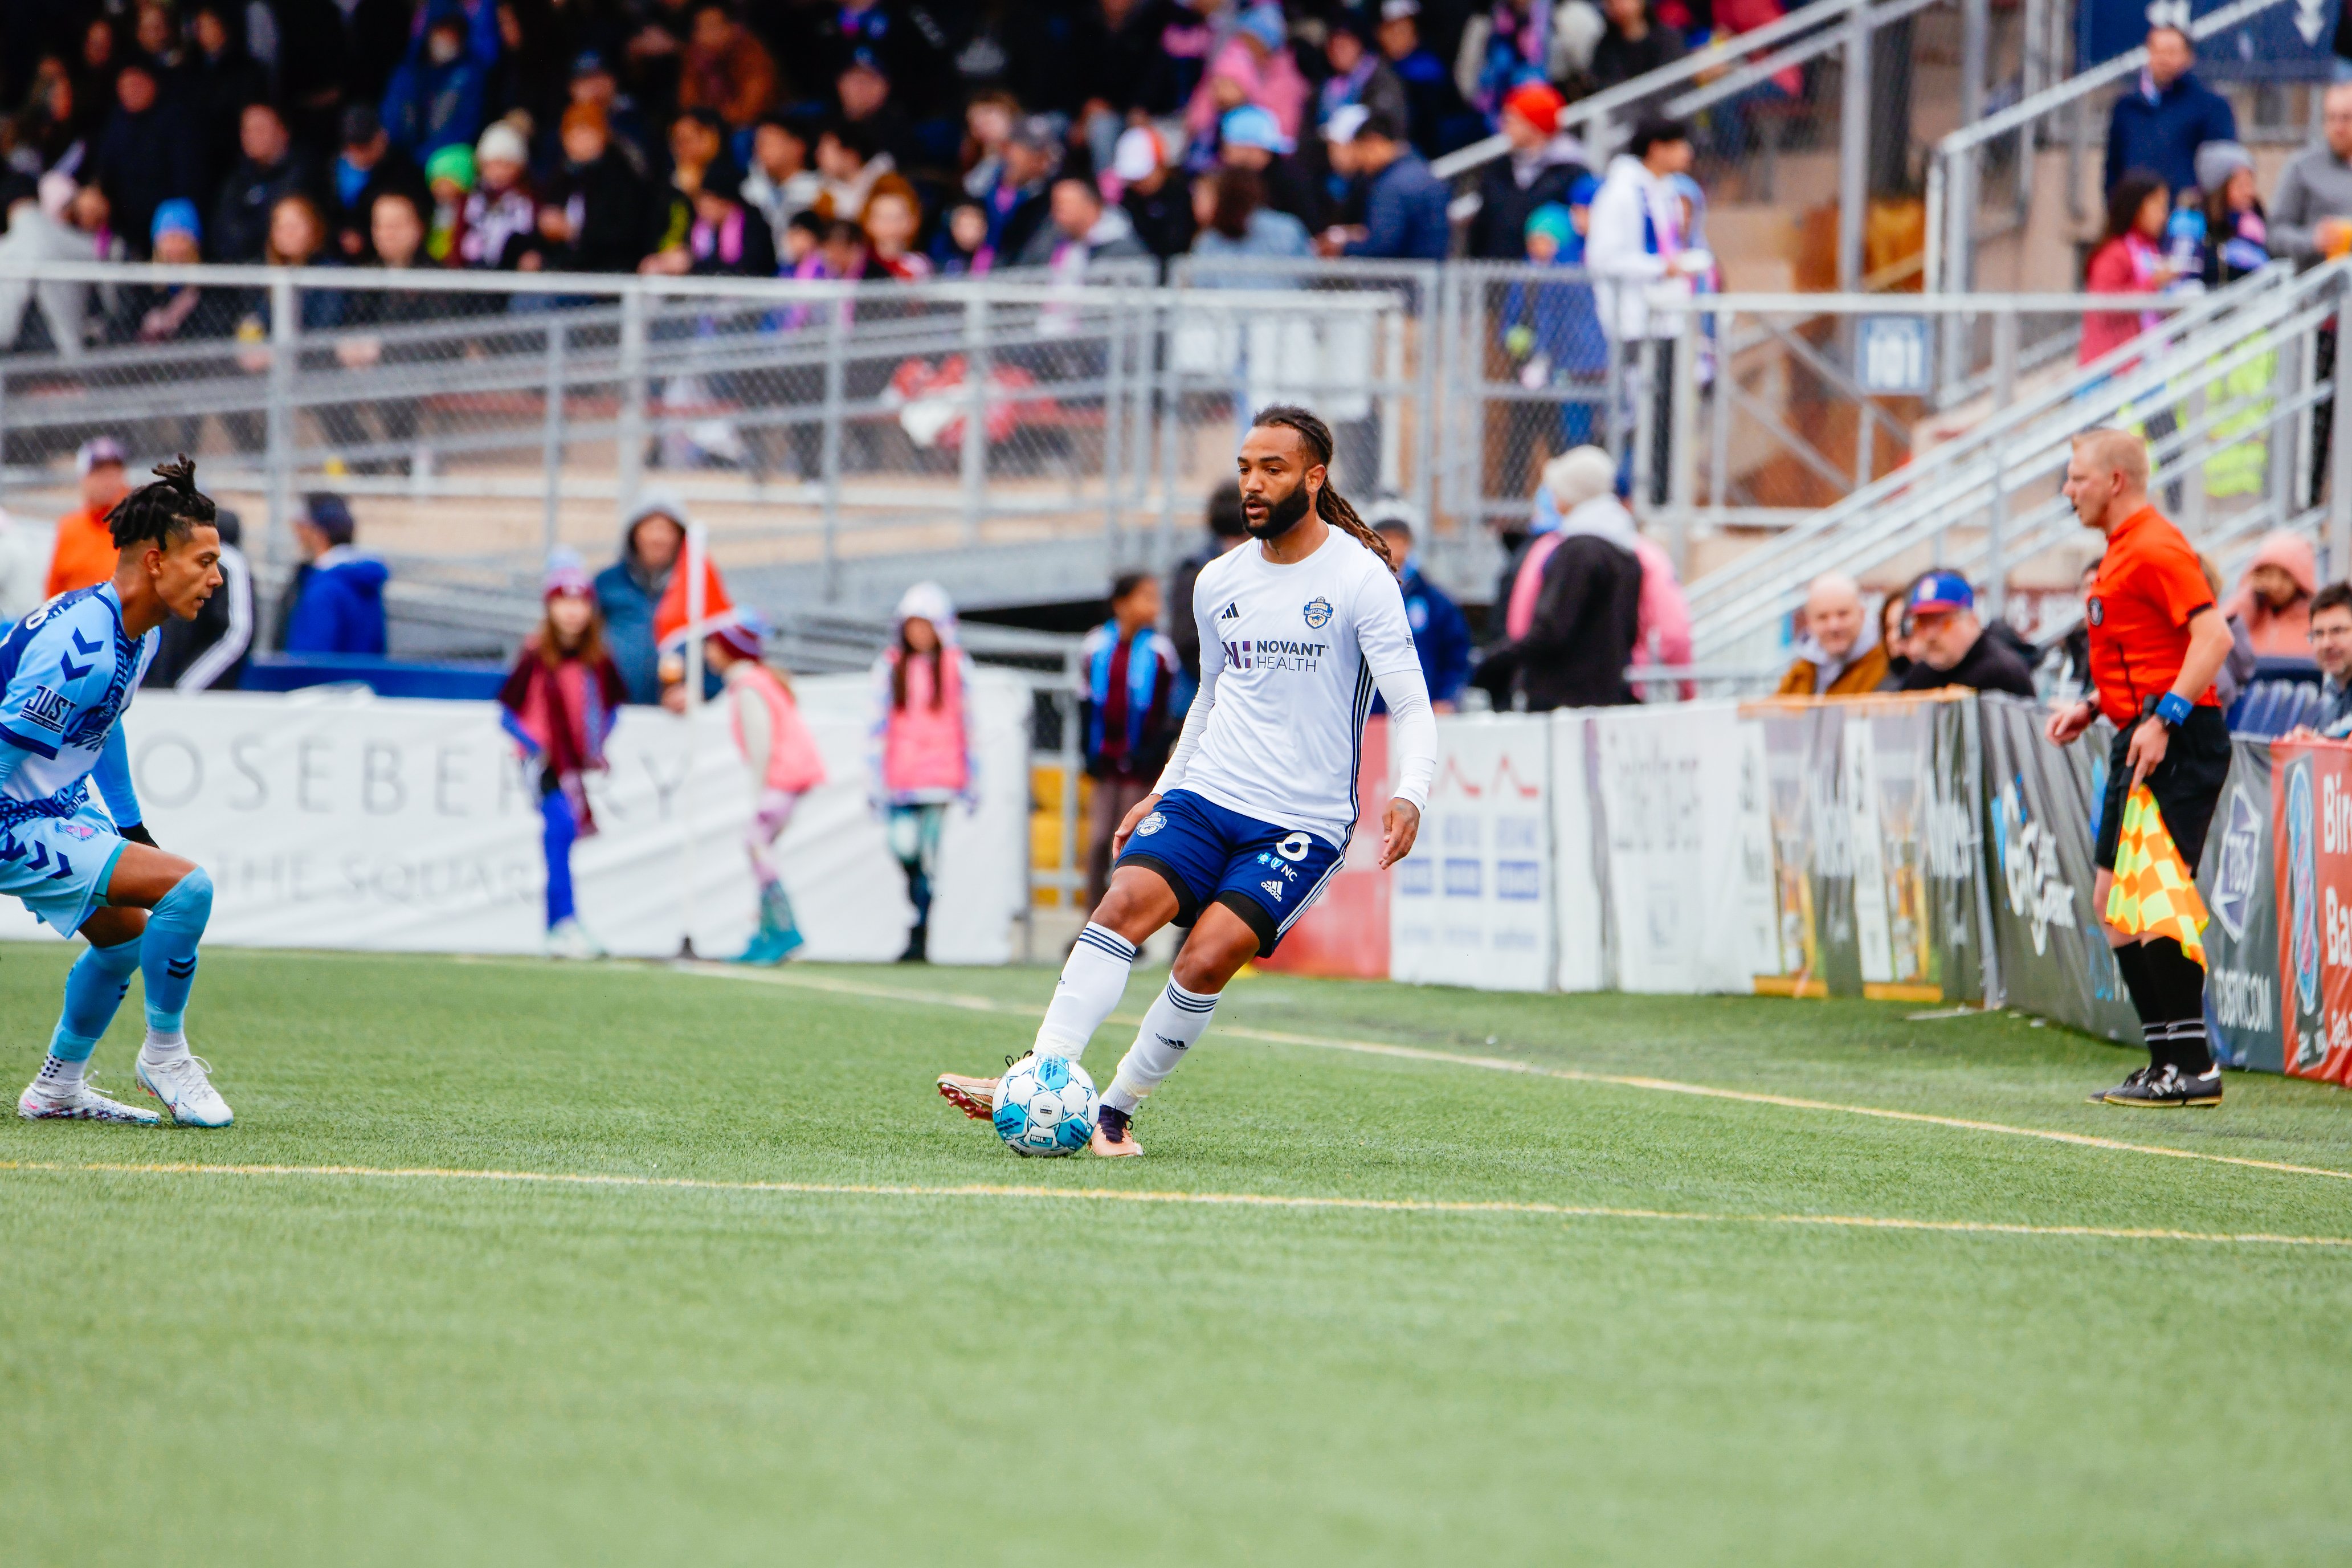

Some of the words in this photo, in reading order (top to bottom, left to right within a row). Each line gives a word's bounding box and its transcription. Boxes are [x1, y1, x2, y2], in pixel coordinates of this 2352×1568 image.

[1257, 640, 1326, 657] NOVANT
[1257, 656, 1317, 672] HEALTH
[24, 685, 77, 726] JUST
[1281, 864, 1298, 882] NC
[1260, 881, 1283, 903] adidas
[1155, 1032, 1189, 1051] adidas
